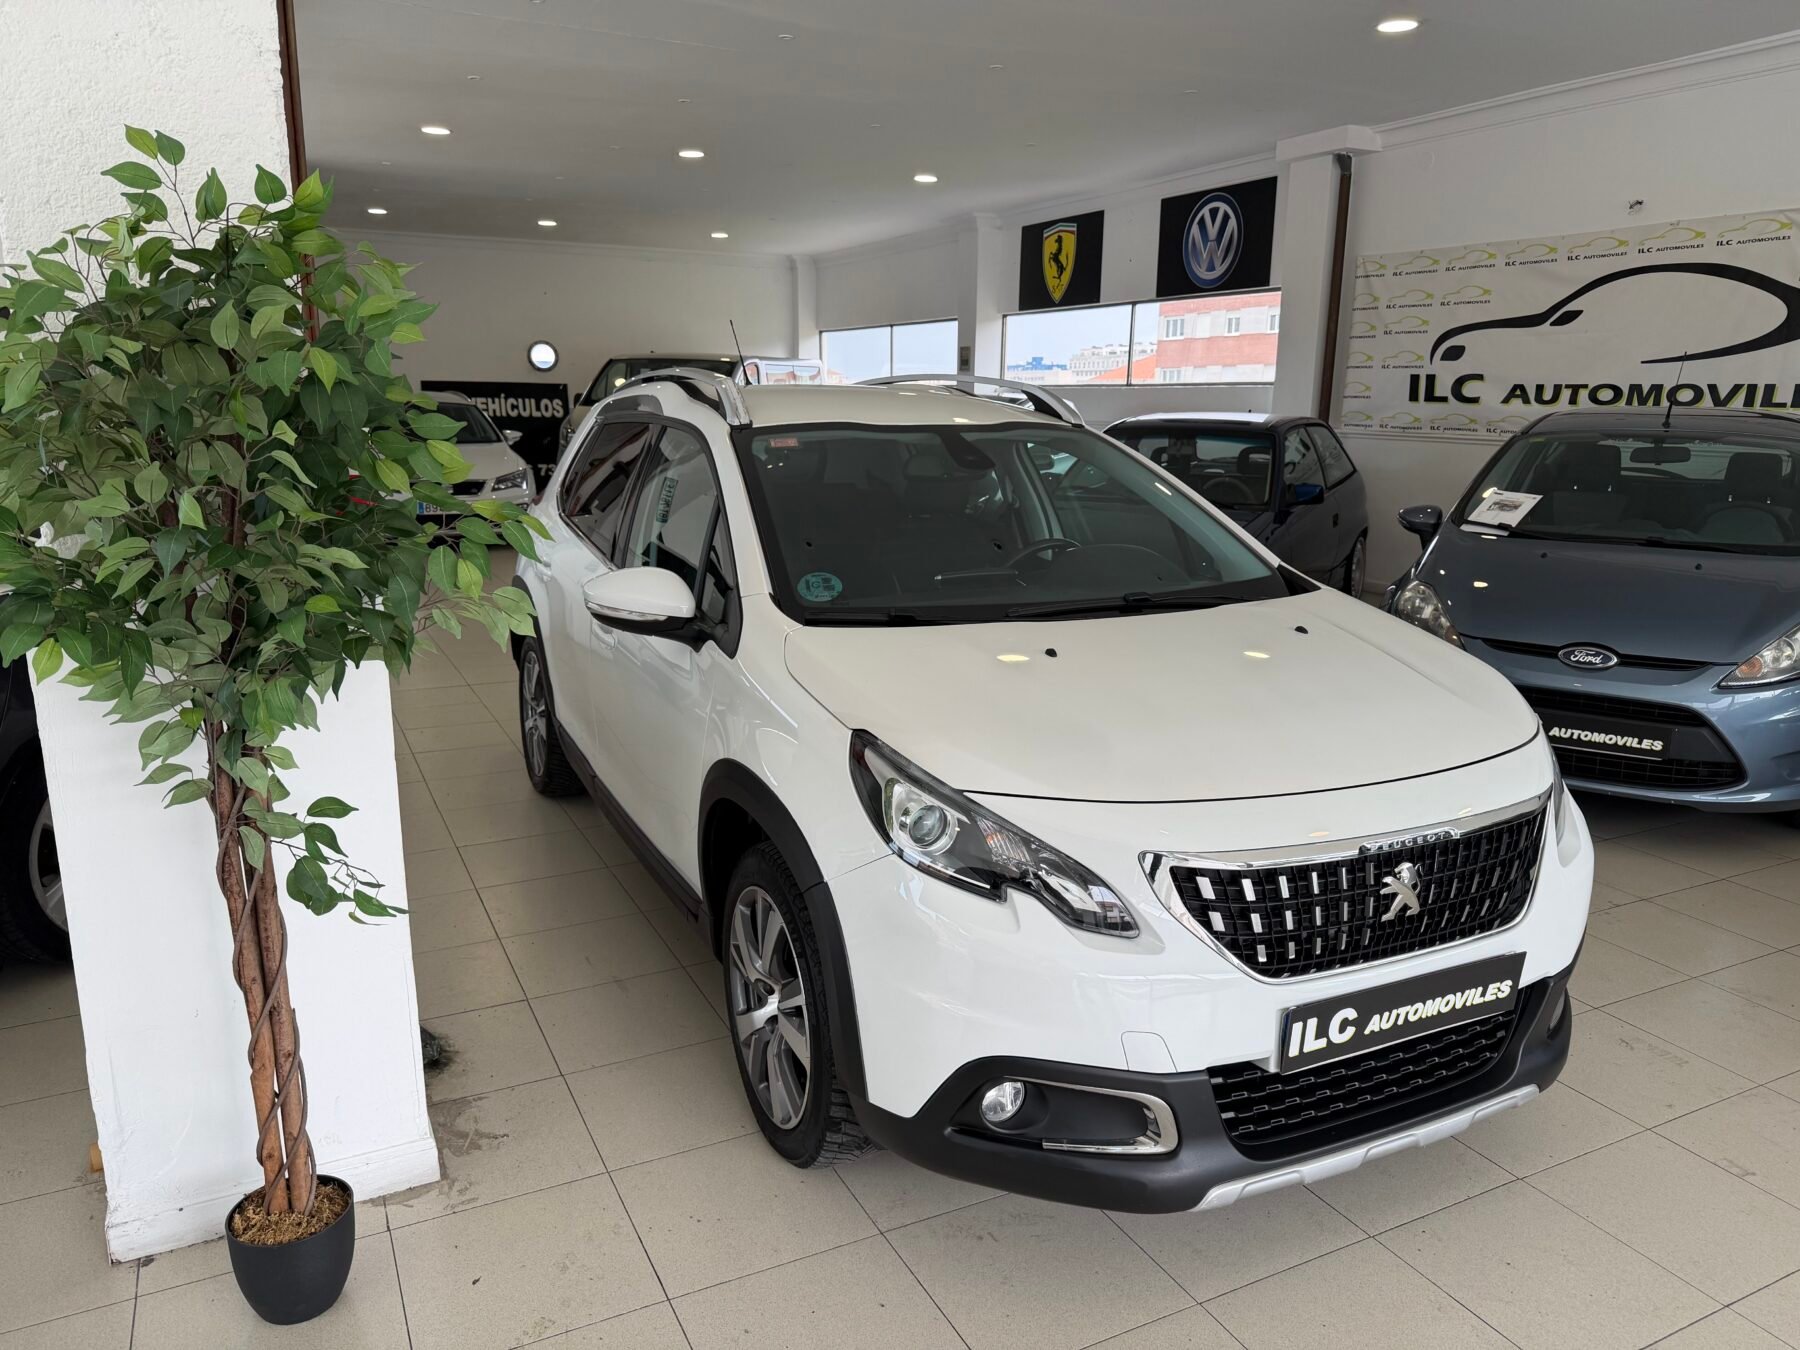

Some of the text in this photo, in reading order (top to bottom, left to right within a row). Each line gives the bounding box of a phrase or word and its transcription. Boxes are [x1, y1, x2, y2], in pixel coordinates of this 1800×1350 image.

[1736, 235, 1791, 246] AUTOMOVILES
[1655, 244, 1704, 252] AUTOMOVILES
[1519, 258, 1557, 266] AUTOMOVILES
[1583, 252, 1627, 260] AUTOMOVILES
[1408, 374, 1484, 404] ILC
[1570, 650, 1604, 664] Ford
[1549, 727, 1663, 751] AUTOMOVILES
[1371, 832, 1446, 852] PEUGEOT
[1288, 980, 1513, 1058] ILC AUTOMOVILES
